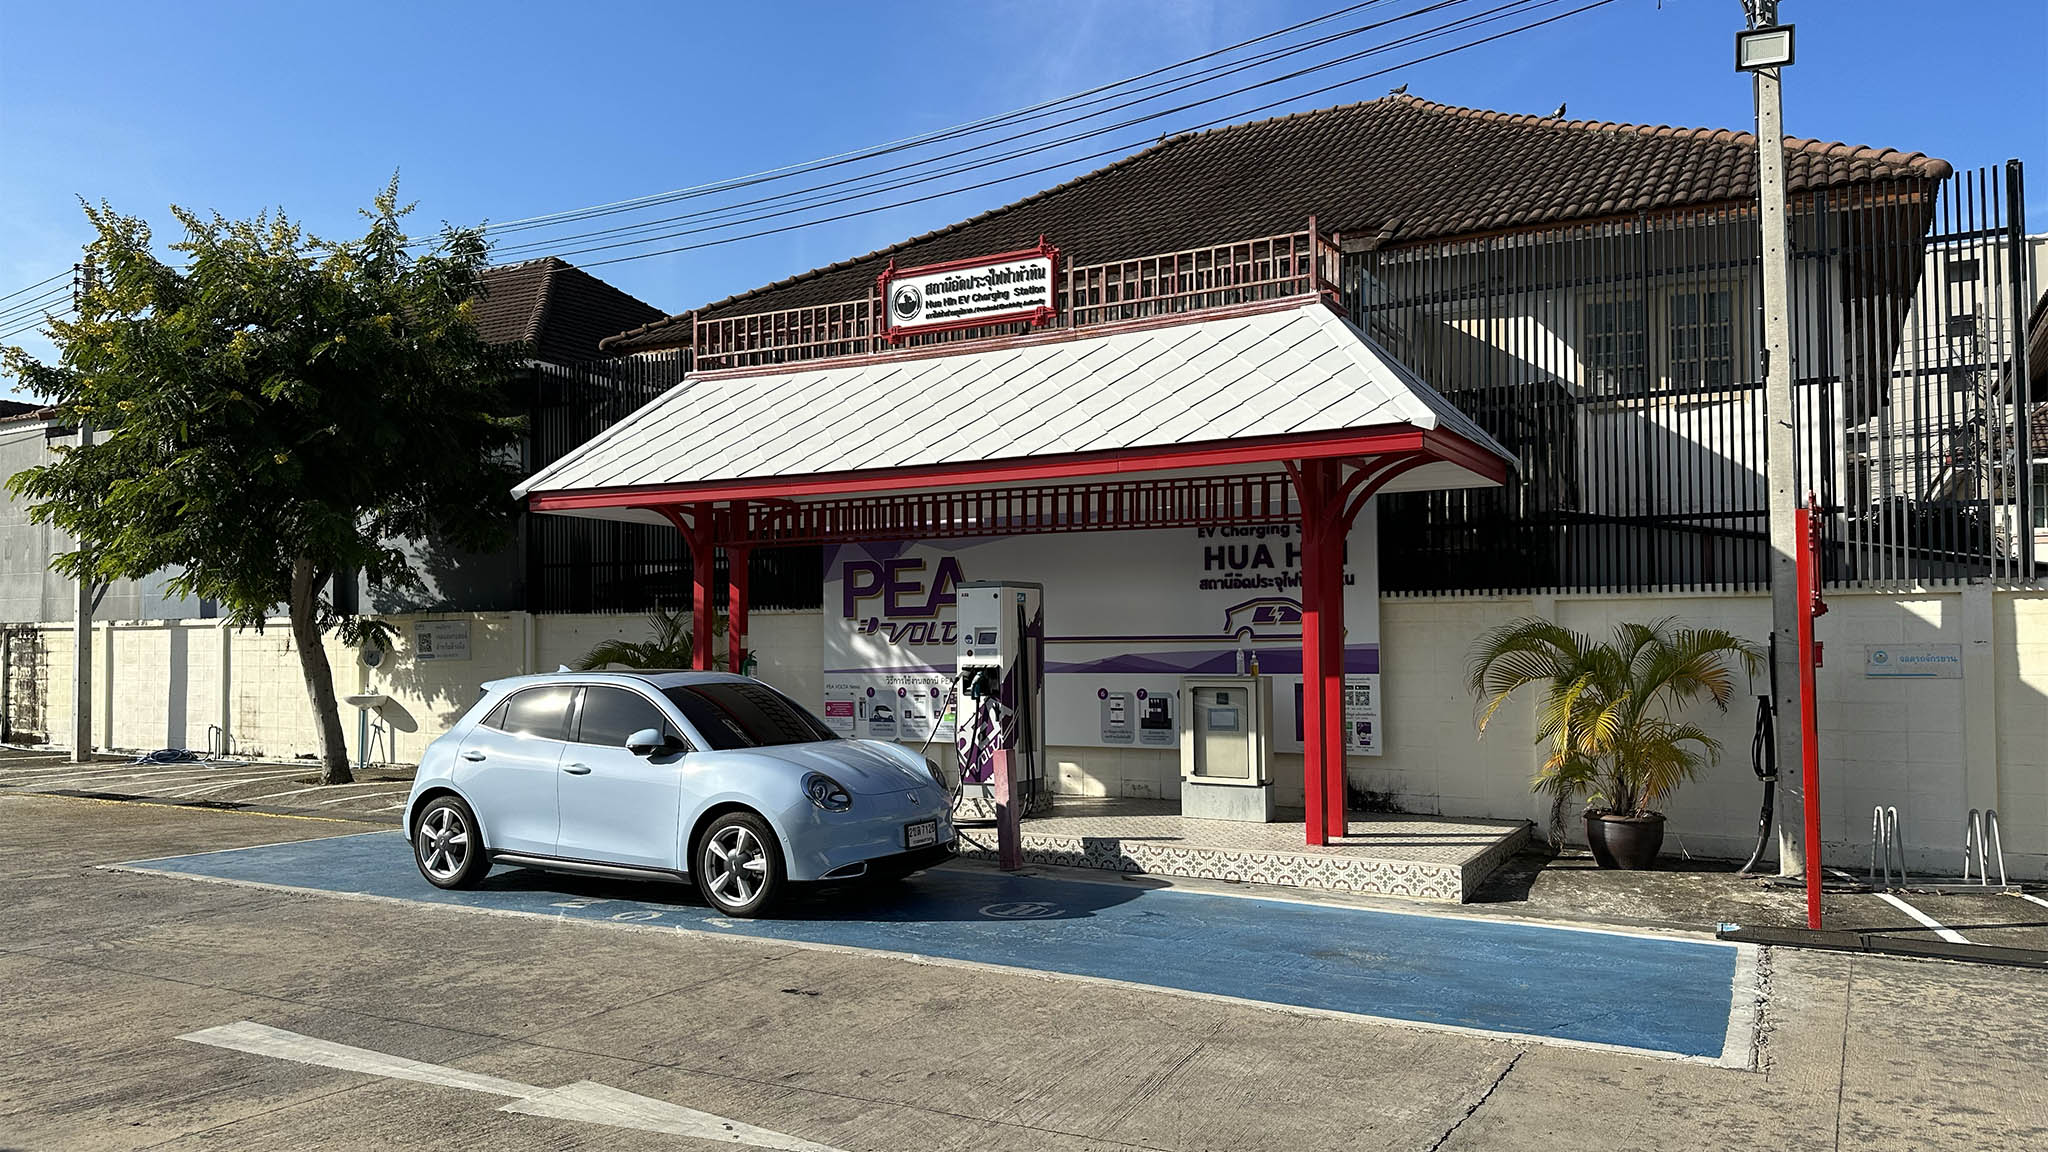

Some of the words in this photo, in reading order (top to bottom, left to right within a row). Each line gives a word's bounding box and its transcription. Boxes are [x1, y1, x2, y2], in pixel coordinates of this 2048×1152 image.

[925, 300, 942, 309] Hua
[943, 297, 957, 307] Hin
[958, 295, 970, 305] EV
[971, 290, 1010, 303] Charging
[1013, 285, 1046, 297] Station
[1198, 526, 1216, 539] EV
[1220, 524, 1290, 539] Charging
[1204, 543, 1275, 571] HUA
[843, 556, 965, 619] PEA
